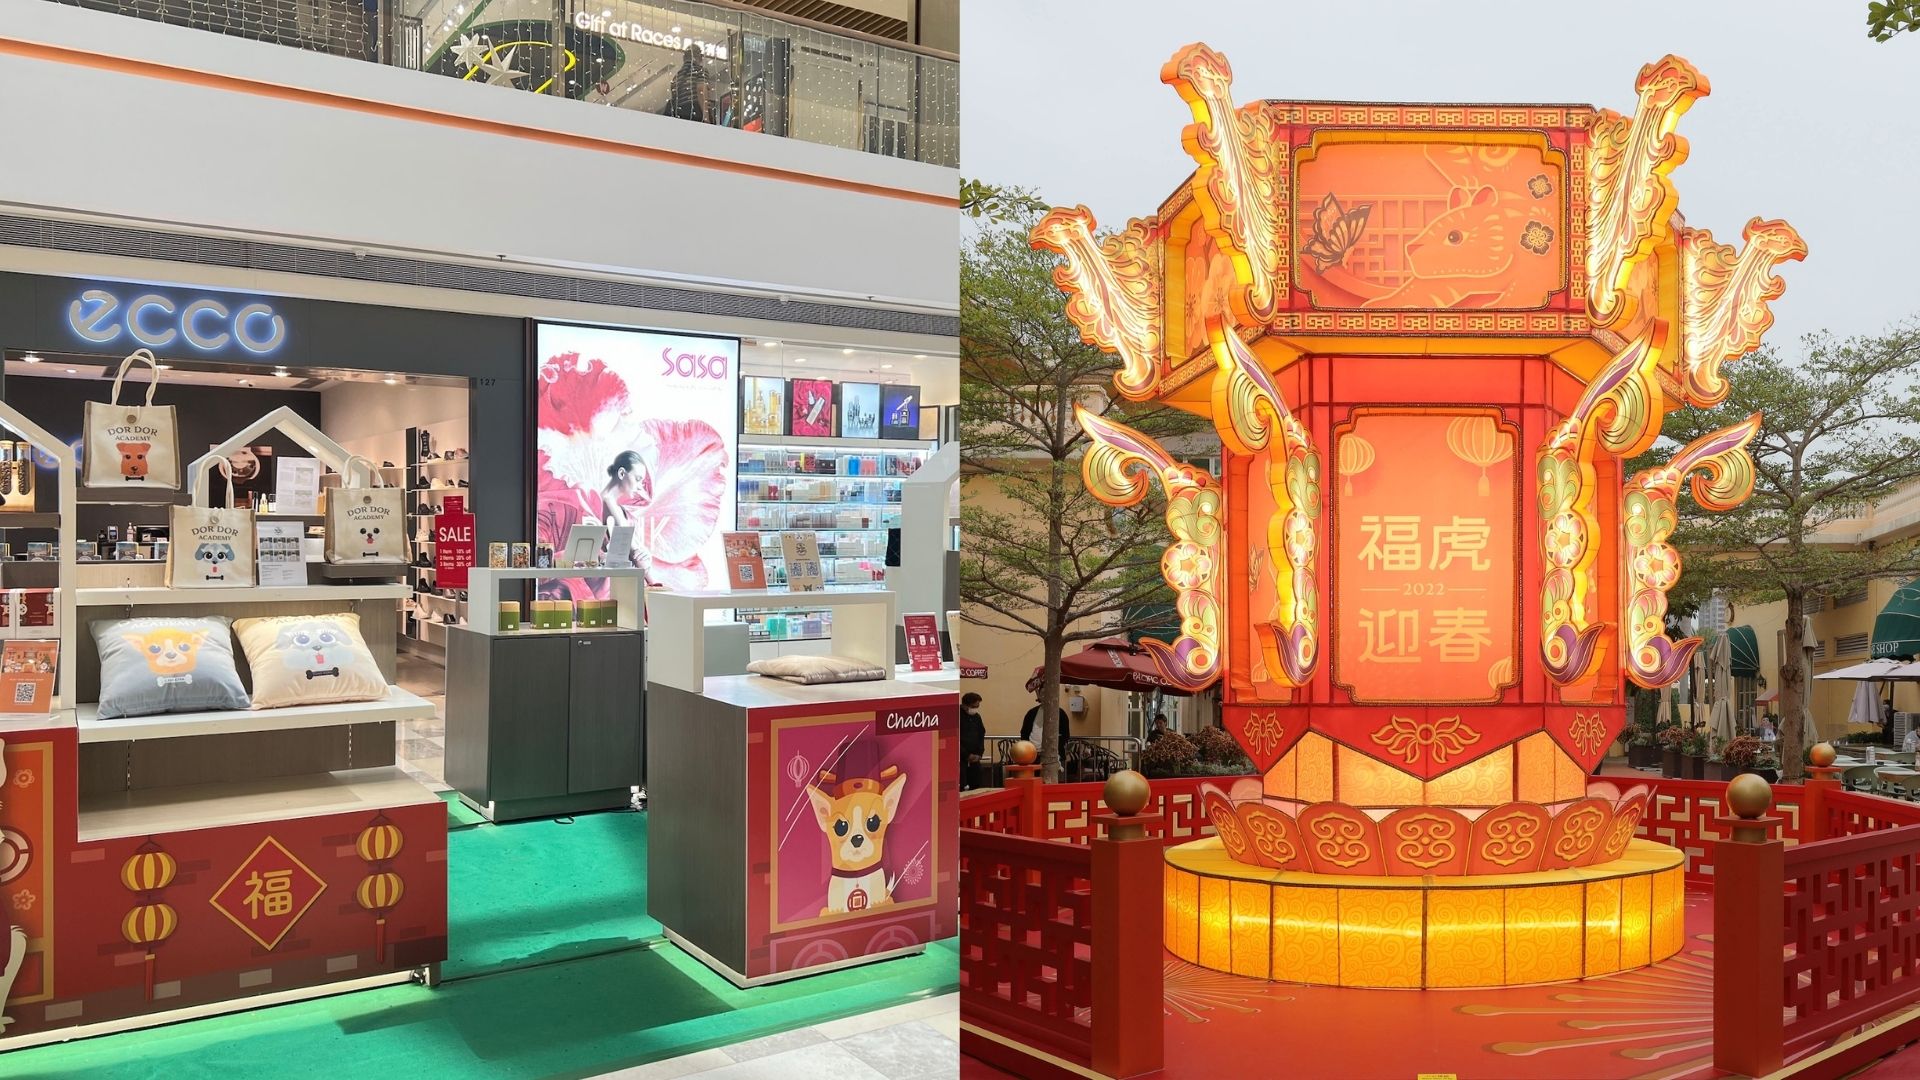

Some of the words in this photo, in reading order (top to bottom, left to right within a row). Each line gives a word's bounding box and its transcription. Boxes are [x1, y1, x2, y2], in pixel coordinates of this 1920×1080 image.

[575, 11, 606, 33] Gift
[609, 22, 628, 38] at
[631, 24, 681, 49] Races
[69, 290, 285, 353] ecco
[480, 378, 496, 386] 127
[107, 426, 131, 435] DOR
[135, 426, 158, 436] DOR
[347, 506, 368, 516] DOR
[370, 506, 391, 515] DOR
[191, 526, 214, 535] DOR
[217, 526, 239, 536] DOR
[439, 526, 471, 542] SALE
[1357, 515, 1491, 571] 福虎
[1403, 582, 1445, 596] 2022
[1357, 607, 1493, 663] 迎春
[1875, 642, 1899, 654] SHOP
[1132, 671, 1159, 684] PACIFIC
[886, 711, 939, 729] ChaCha
[243, 870, 293, 920] 福
